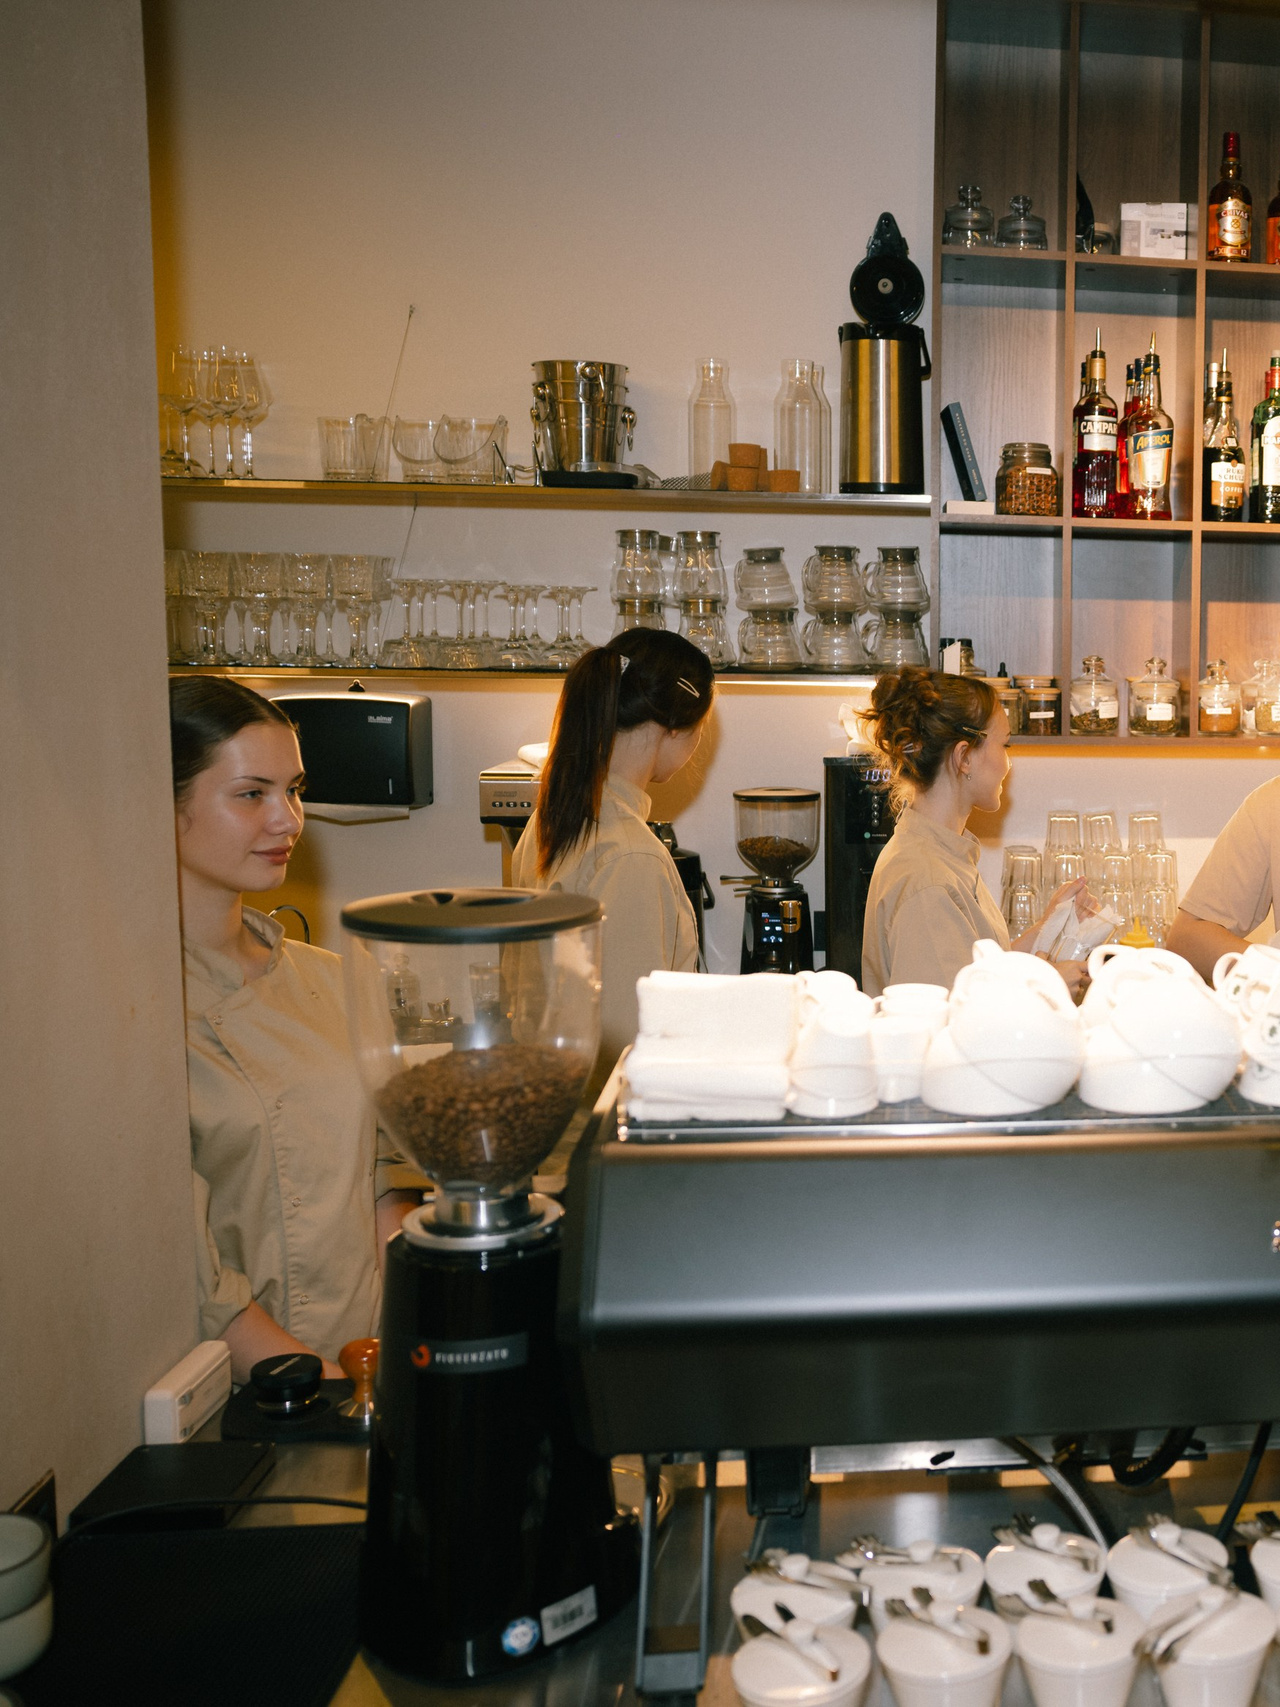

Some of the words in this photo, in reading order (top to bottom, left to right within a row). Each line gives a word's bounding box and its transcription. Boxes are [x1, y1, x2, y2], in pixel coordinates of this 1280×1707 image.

[1221, 209, 1248, 219] CHIVAS
[1080, 421, 1118, 434] CAMPAR
[1136, 434, 1171, 450] APEROL
